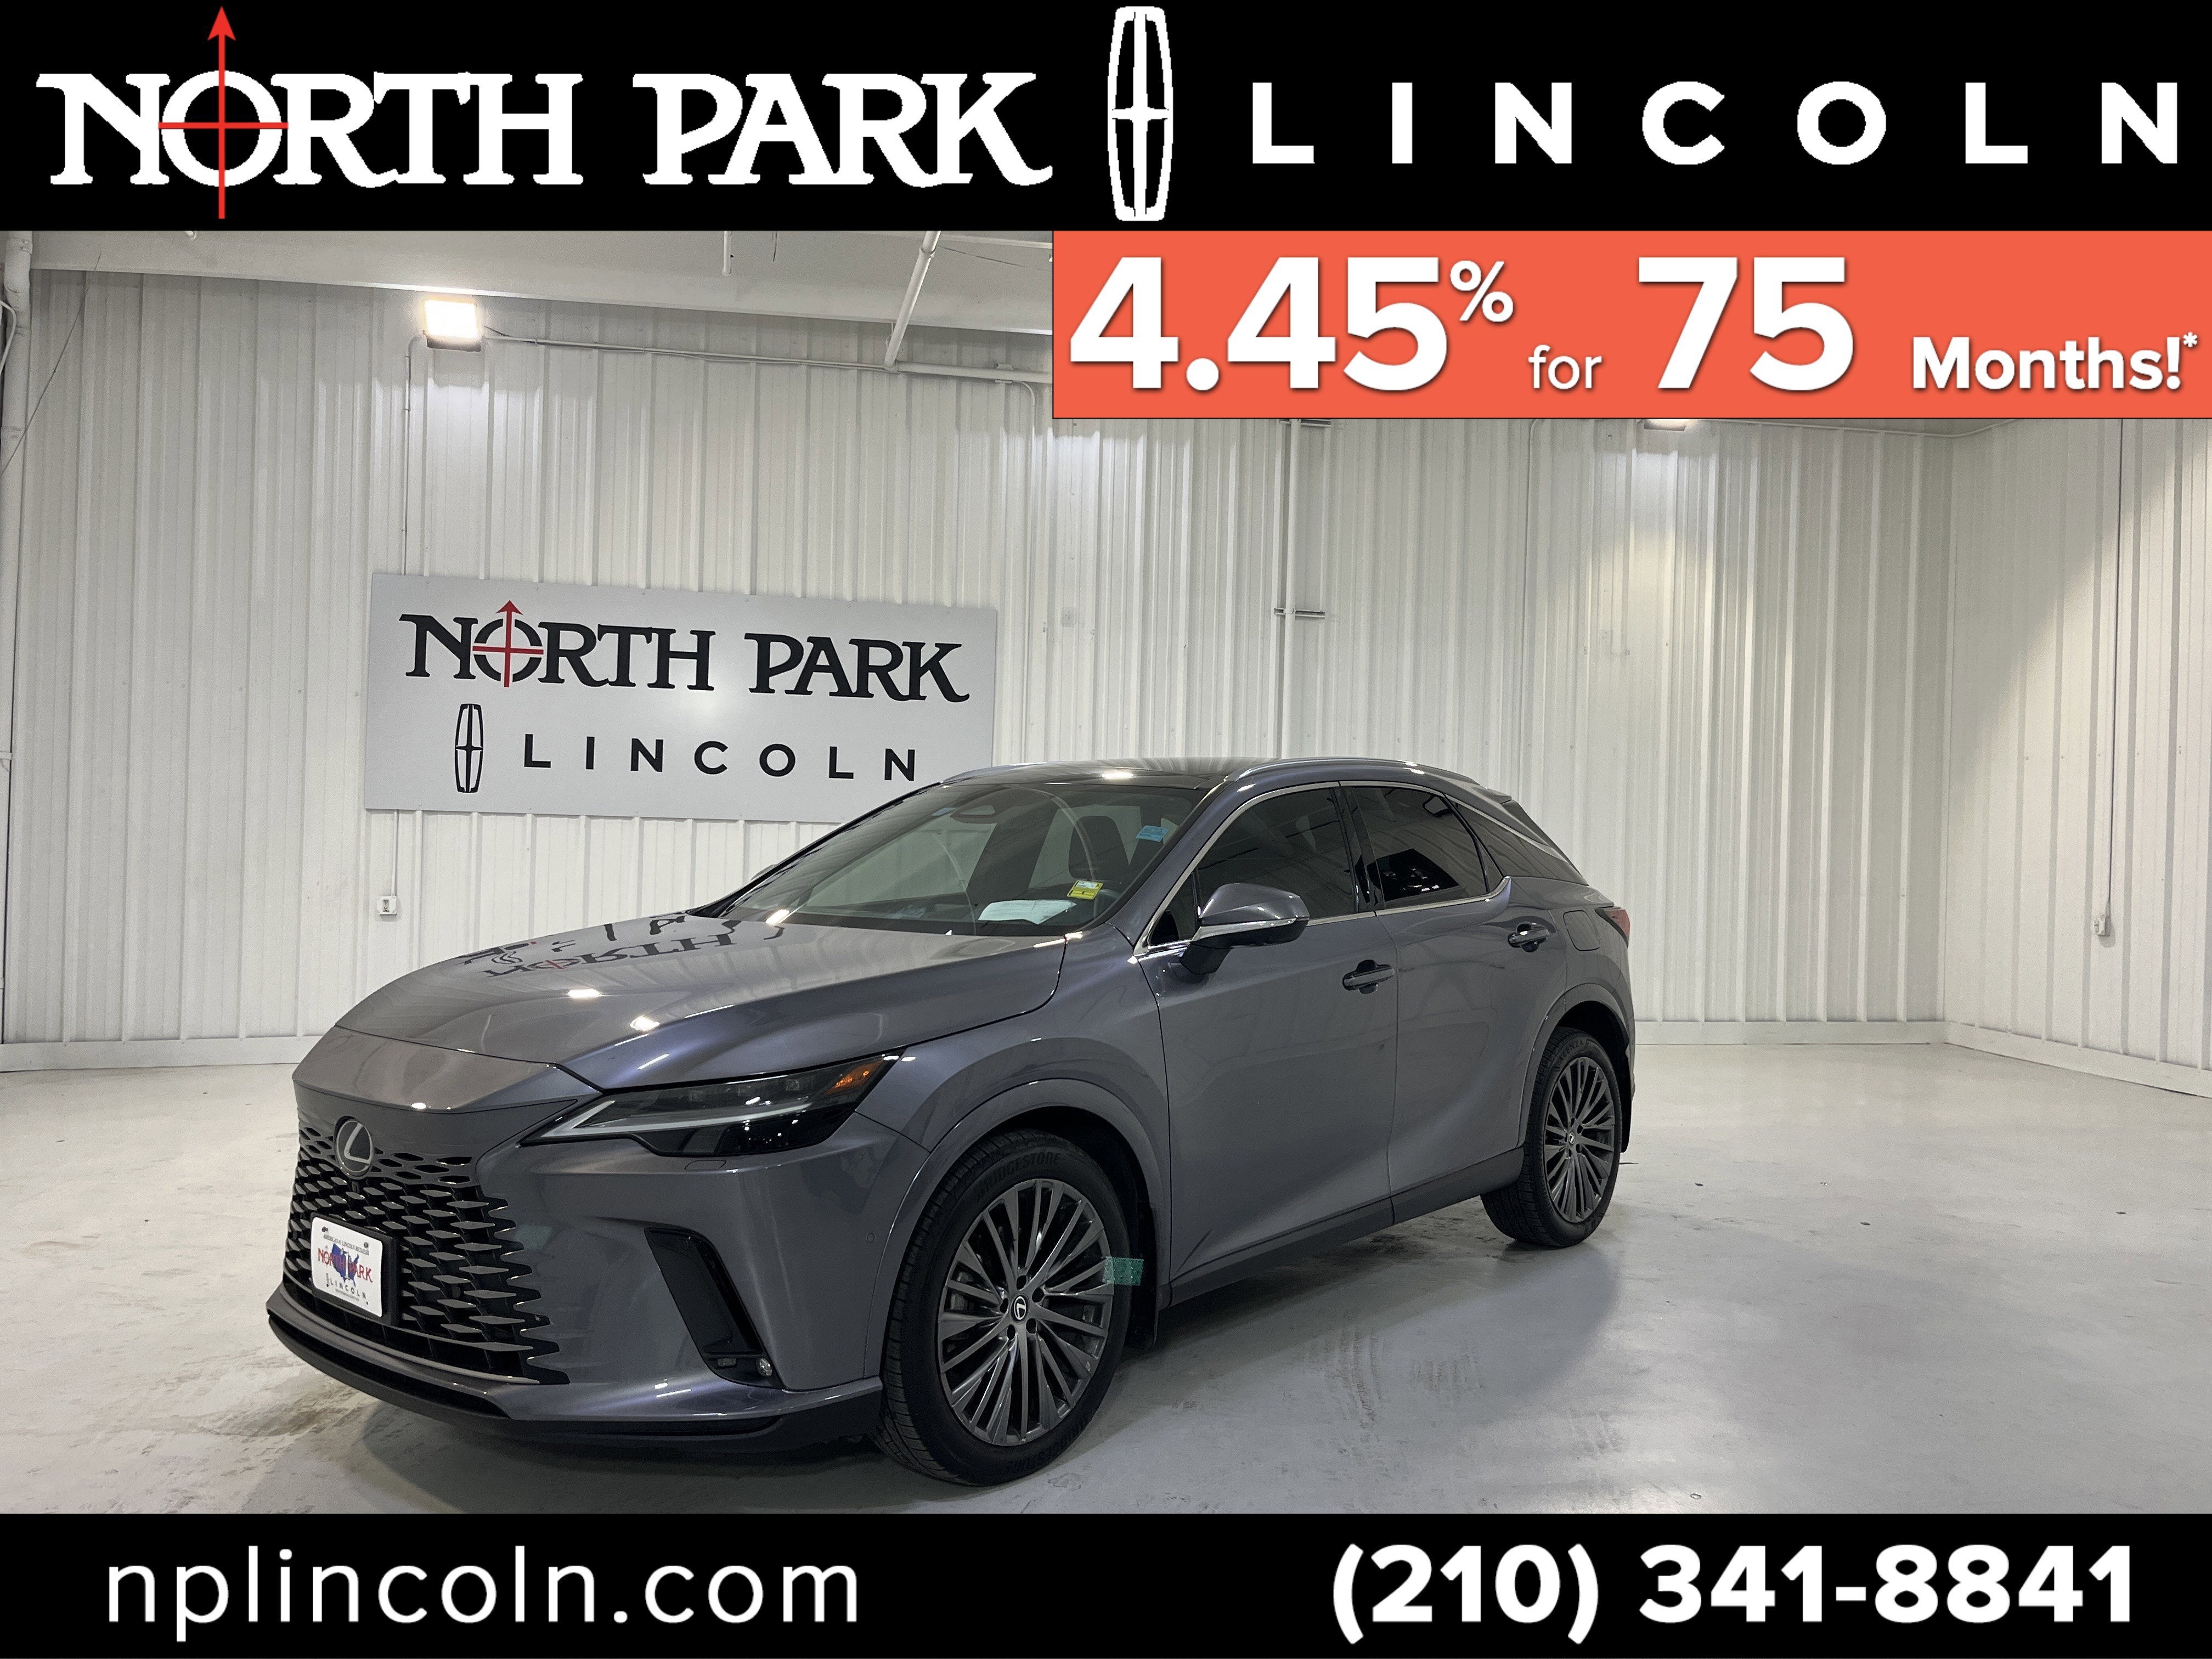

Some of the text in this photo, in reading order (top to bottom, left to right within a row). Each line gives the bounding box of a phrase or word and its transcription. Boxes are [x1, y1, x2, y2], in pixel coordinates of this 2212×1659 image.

[399, 614, 970, 703] NORTH PARK
[524, 733, 915, 781] LINCOLN
[973, 1152, 1061, 1202] BRIDGESTONE
[318, 1248, 373, 1283] NORTH PARK
[330, 1278, 365, 1299] LINCOLN
